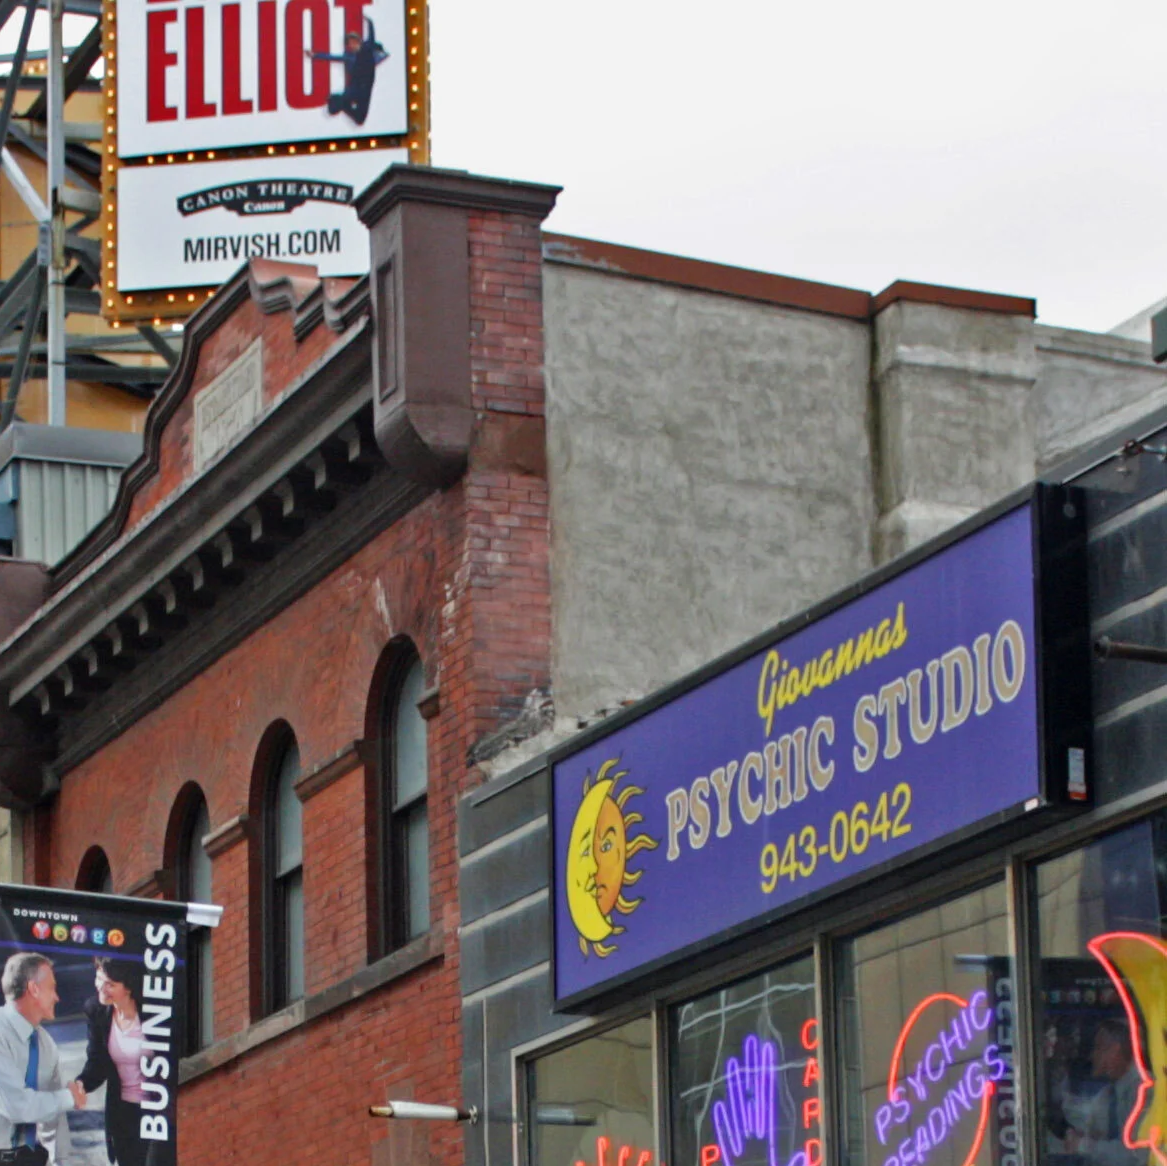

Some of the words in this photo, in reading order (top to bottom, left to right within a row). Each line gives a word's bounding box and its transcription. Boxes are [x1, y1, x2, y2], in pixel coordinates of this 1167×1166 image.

[183, 185, 249, 211] CANON
[258, 182, 348, 201] THEATRE
[183, 229, 341, 263] MIRVISH.COM
[756, 600, 908, 737] Giovannas
[665, 715, 835, 862] PSYCHIC
[852, 619, 1026, 773] STUDIO
[759, 783, 912, 894] 943-0642
[13, 908, 79, 922] DOWNTOWN
[140, 922, 177, 1141] BUSINESS
[873, 990, 993, 1145] PSYCHIC
